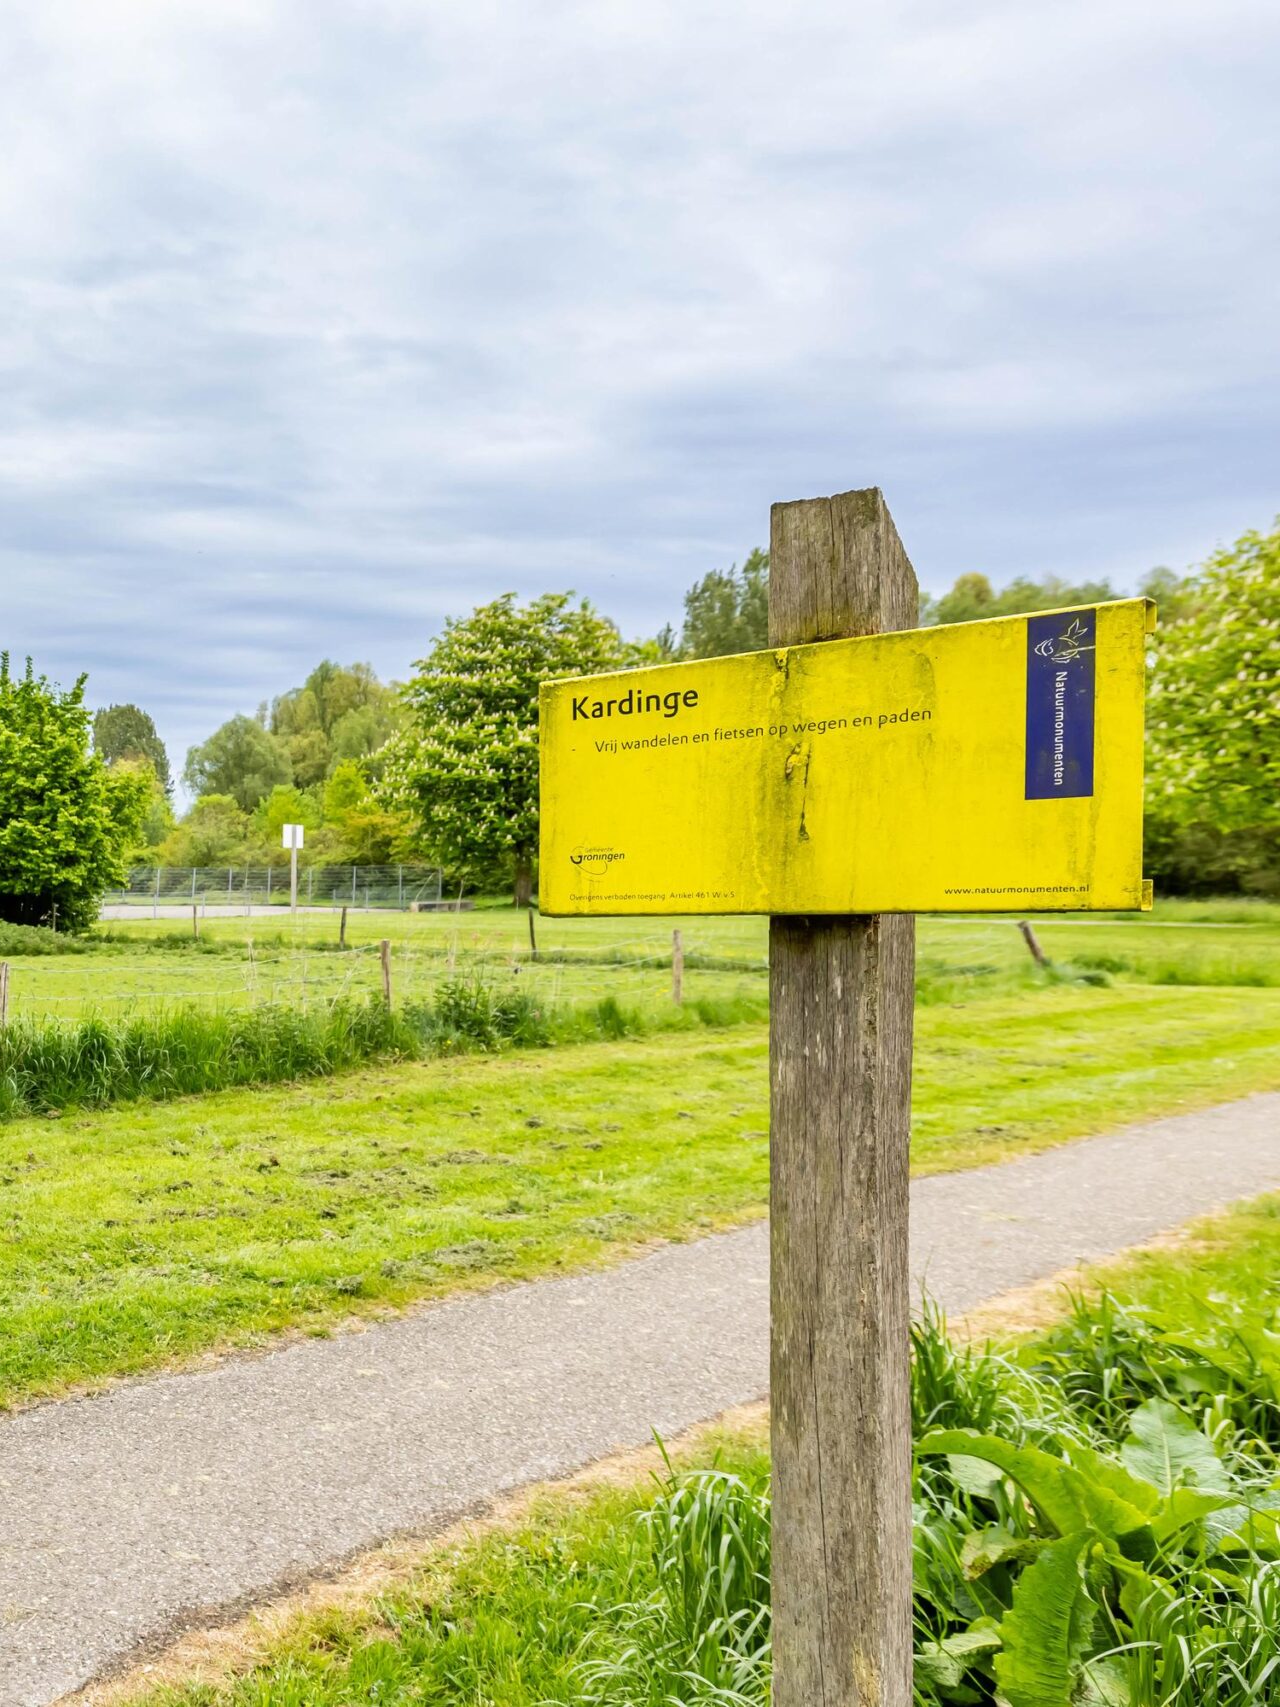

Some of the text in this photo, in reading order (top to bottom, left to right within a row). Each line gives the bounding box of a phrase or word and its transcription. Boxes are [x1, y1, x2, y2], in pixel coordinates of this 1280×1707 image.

[572, 689, 699, 721] Kardinge
[595, 708, 932, 754] Vrij wandelen en fietsen op wegen en paden
[1053, 671, 1068, 786] Natuurmonumenten
[570, 853, 625, 865] Groningen
[569, 893, 603, 902] Overigens
[604, 892, 637, 901] verboden
[638, 892, 666, 902] toegang
[670, 891, 694, 899] Artikel
[944, 884, 1090, 895] www.natuurmonumenten.nl
